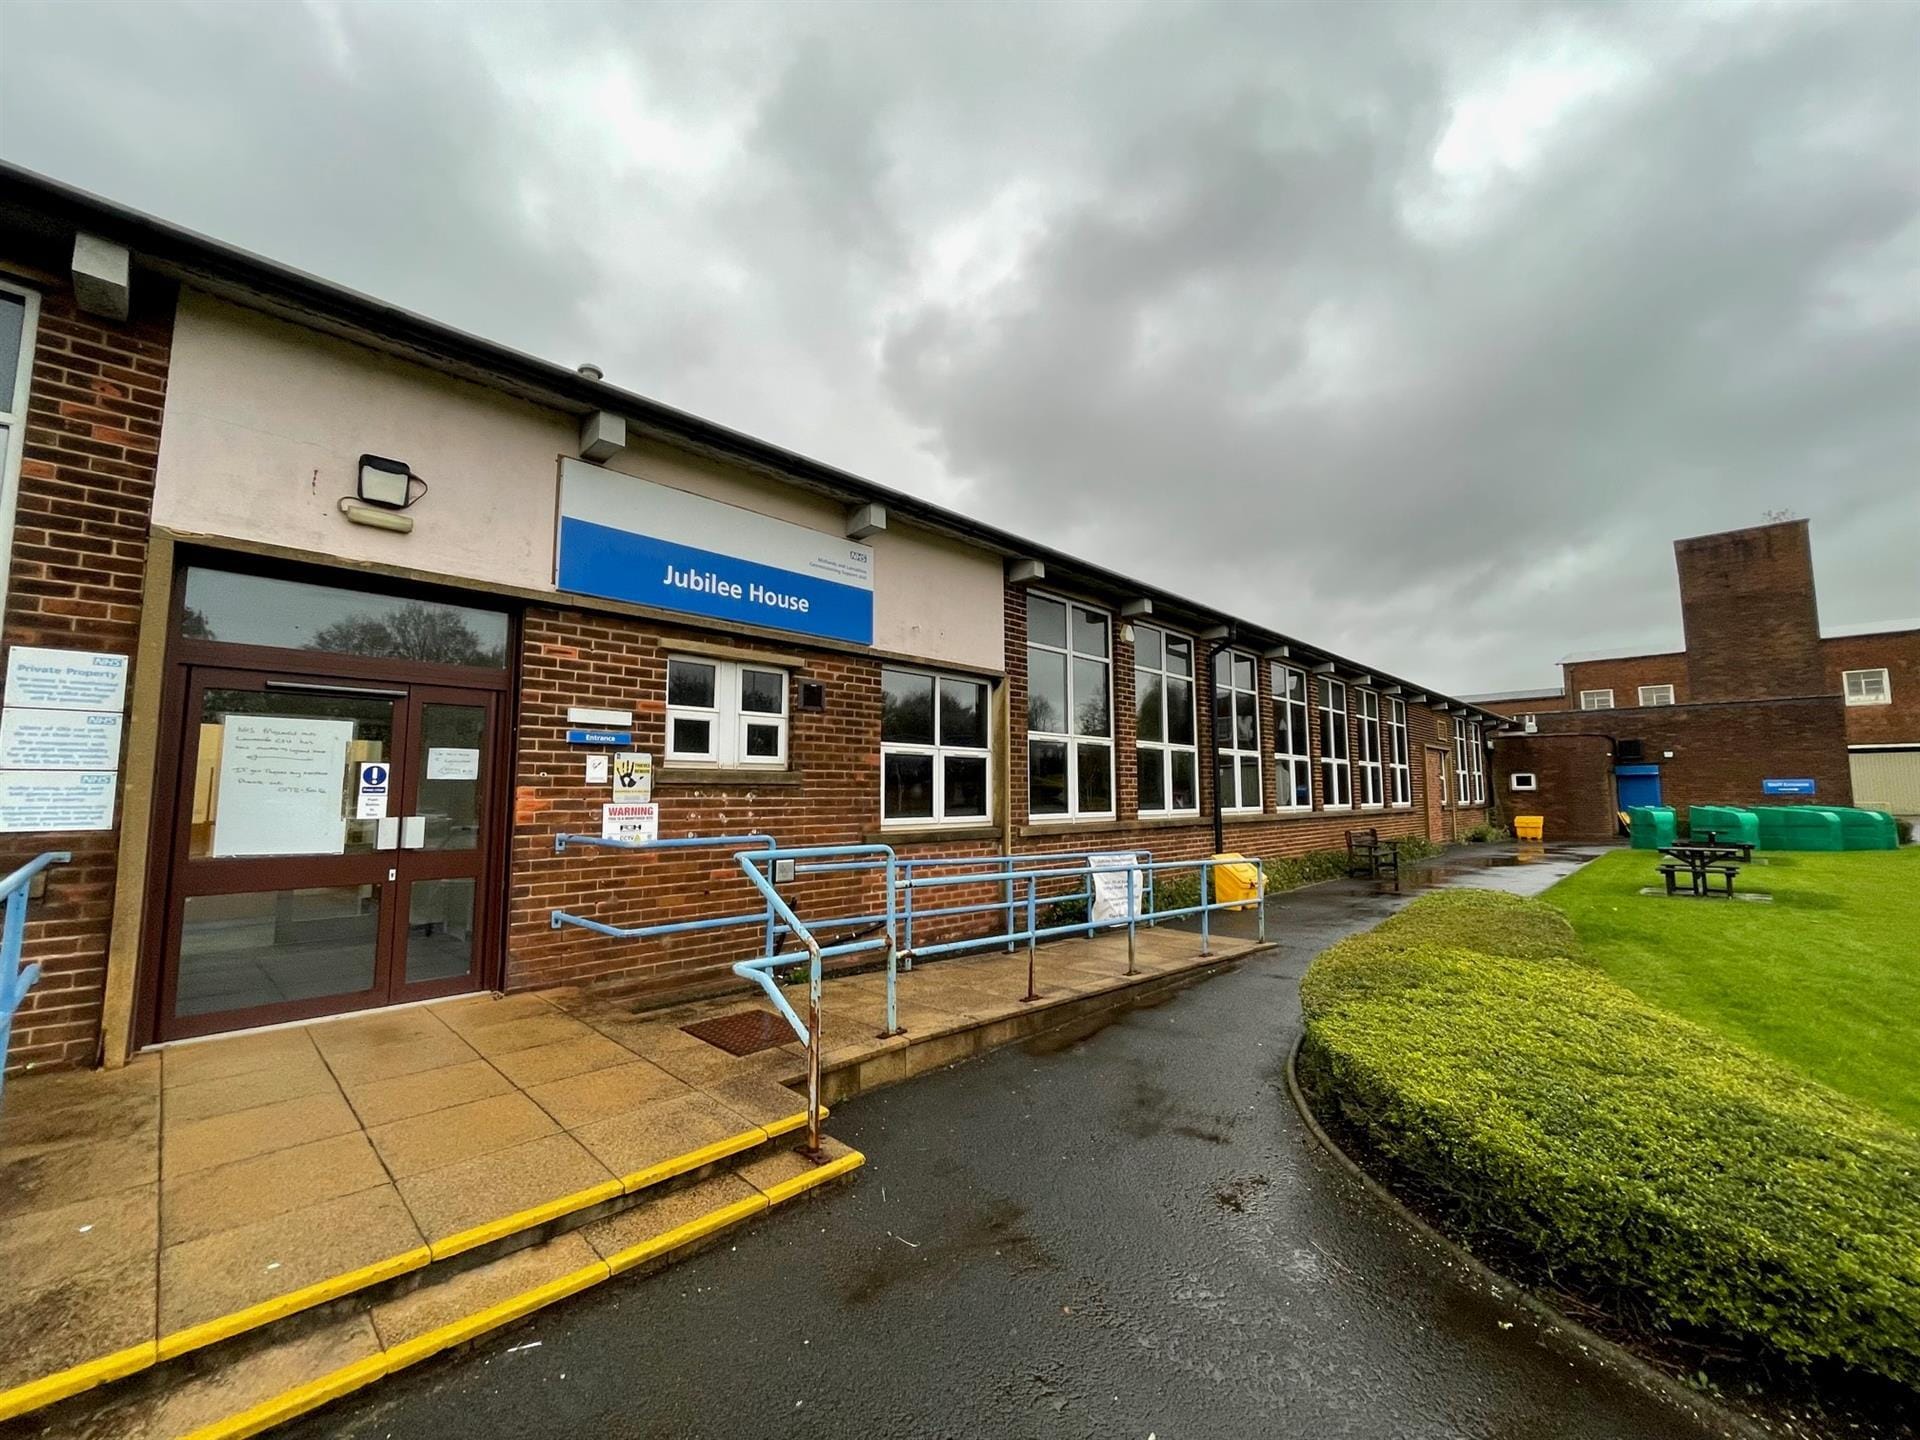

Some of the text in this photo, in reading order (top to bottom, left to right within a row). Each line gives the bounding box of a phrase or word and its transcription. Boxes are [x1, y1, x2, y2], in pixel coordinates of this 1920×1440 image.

[849, 551, 867, 563] NHS
[663, 565, 810, 613] Jubilee House
[94, 657, 121, 667] NHS
[17, 664, 118, 679] Private Property
[87, 716, 116, 725] NHS
[585, 734, 616, 742] Entrance
[81, 775, 111, 784] NHS
[608, 806, 654, 816] WARNING
